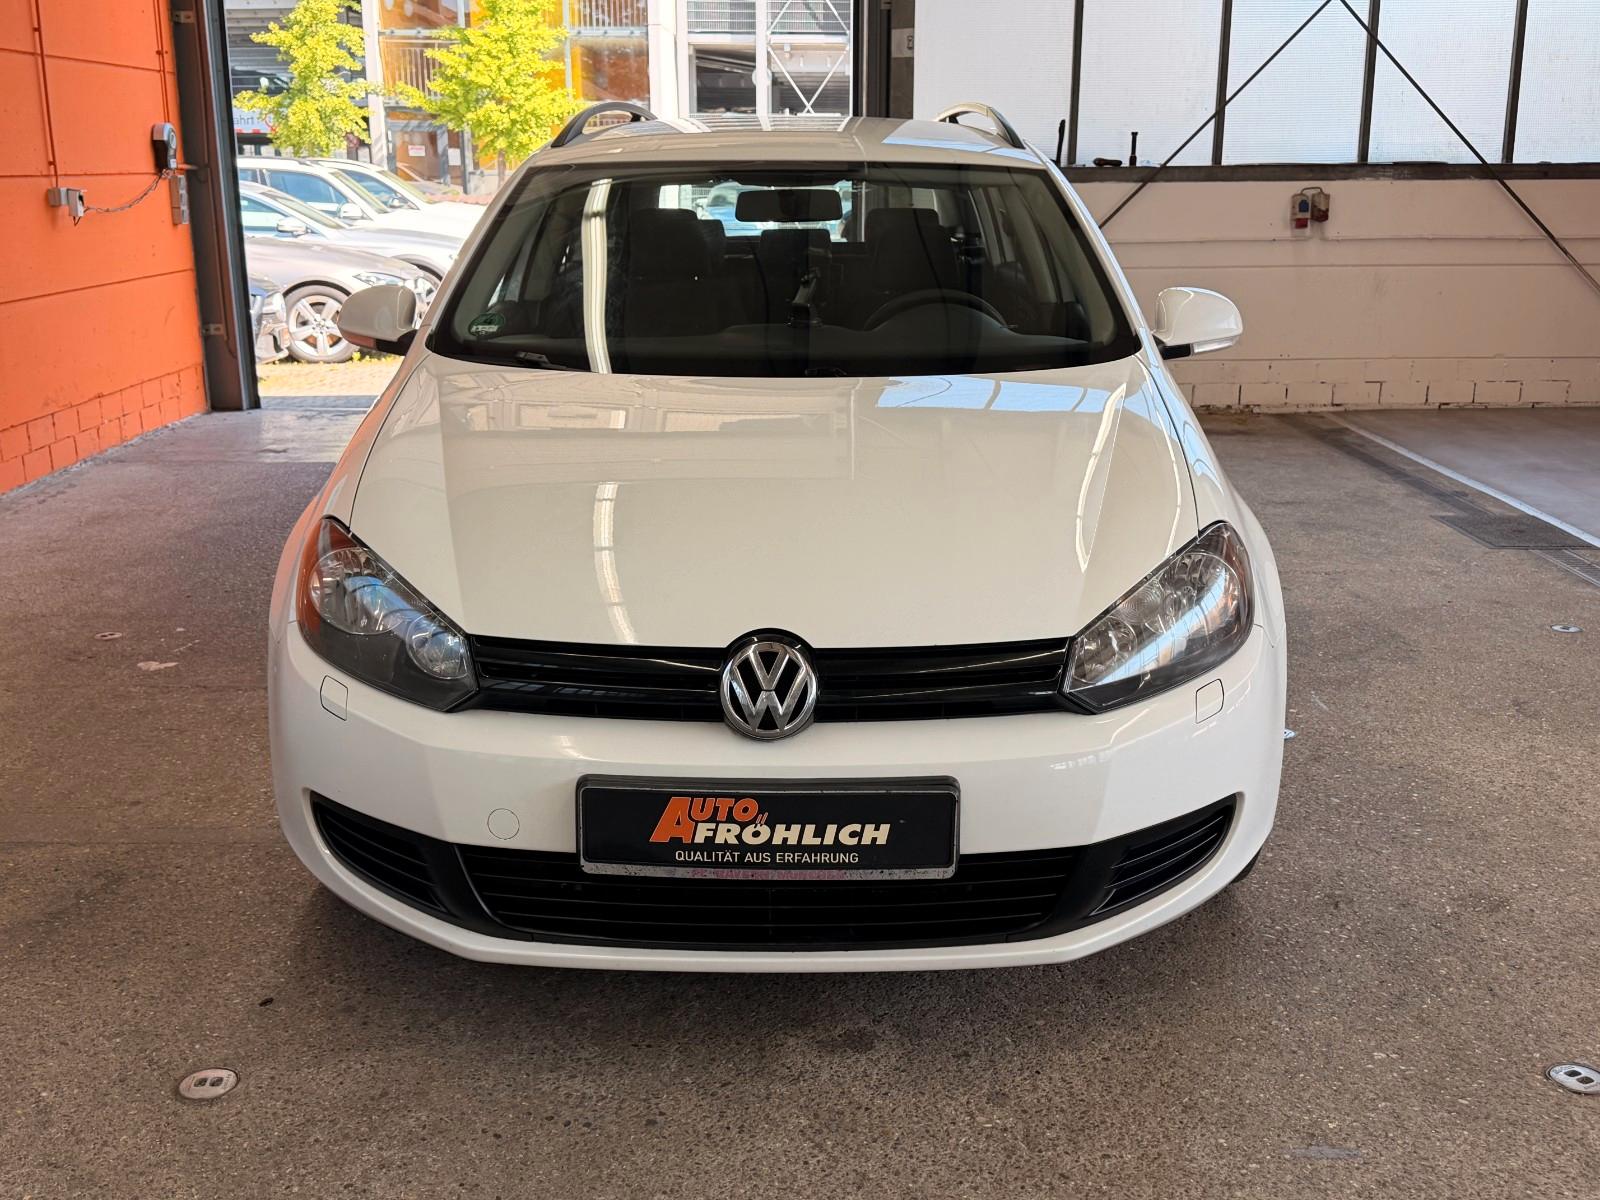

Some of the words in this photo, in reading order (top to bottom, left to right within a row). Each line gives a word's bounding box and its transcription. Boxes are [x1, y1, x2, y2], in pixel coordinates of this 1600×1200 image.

[649, 796, 759, 843] AUTO
[693, 812, 891, 846] FRÖHLICH
[675, 849, 741, 862] QUALITÄT
[744, 852, 771, 863] AUS
[776, 852, 859, 864] ERFAHRUNG
